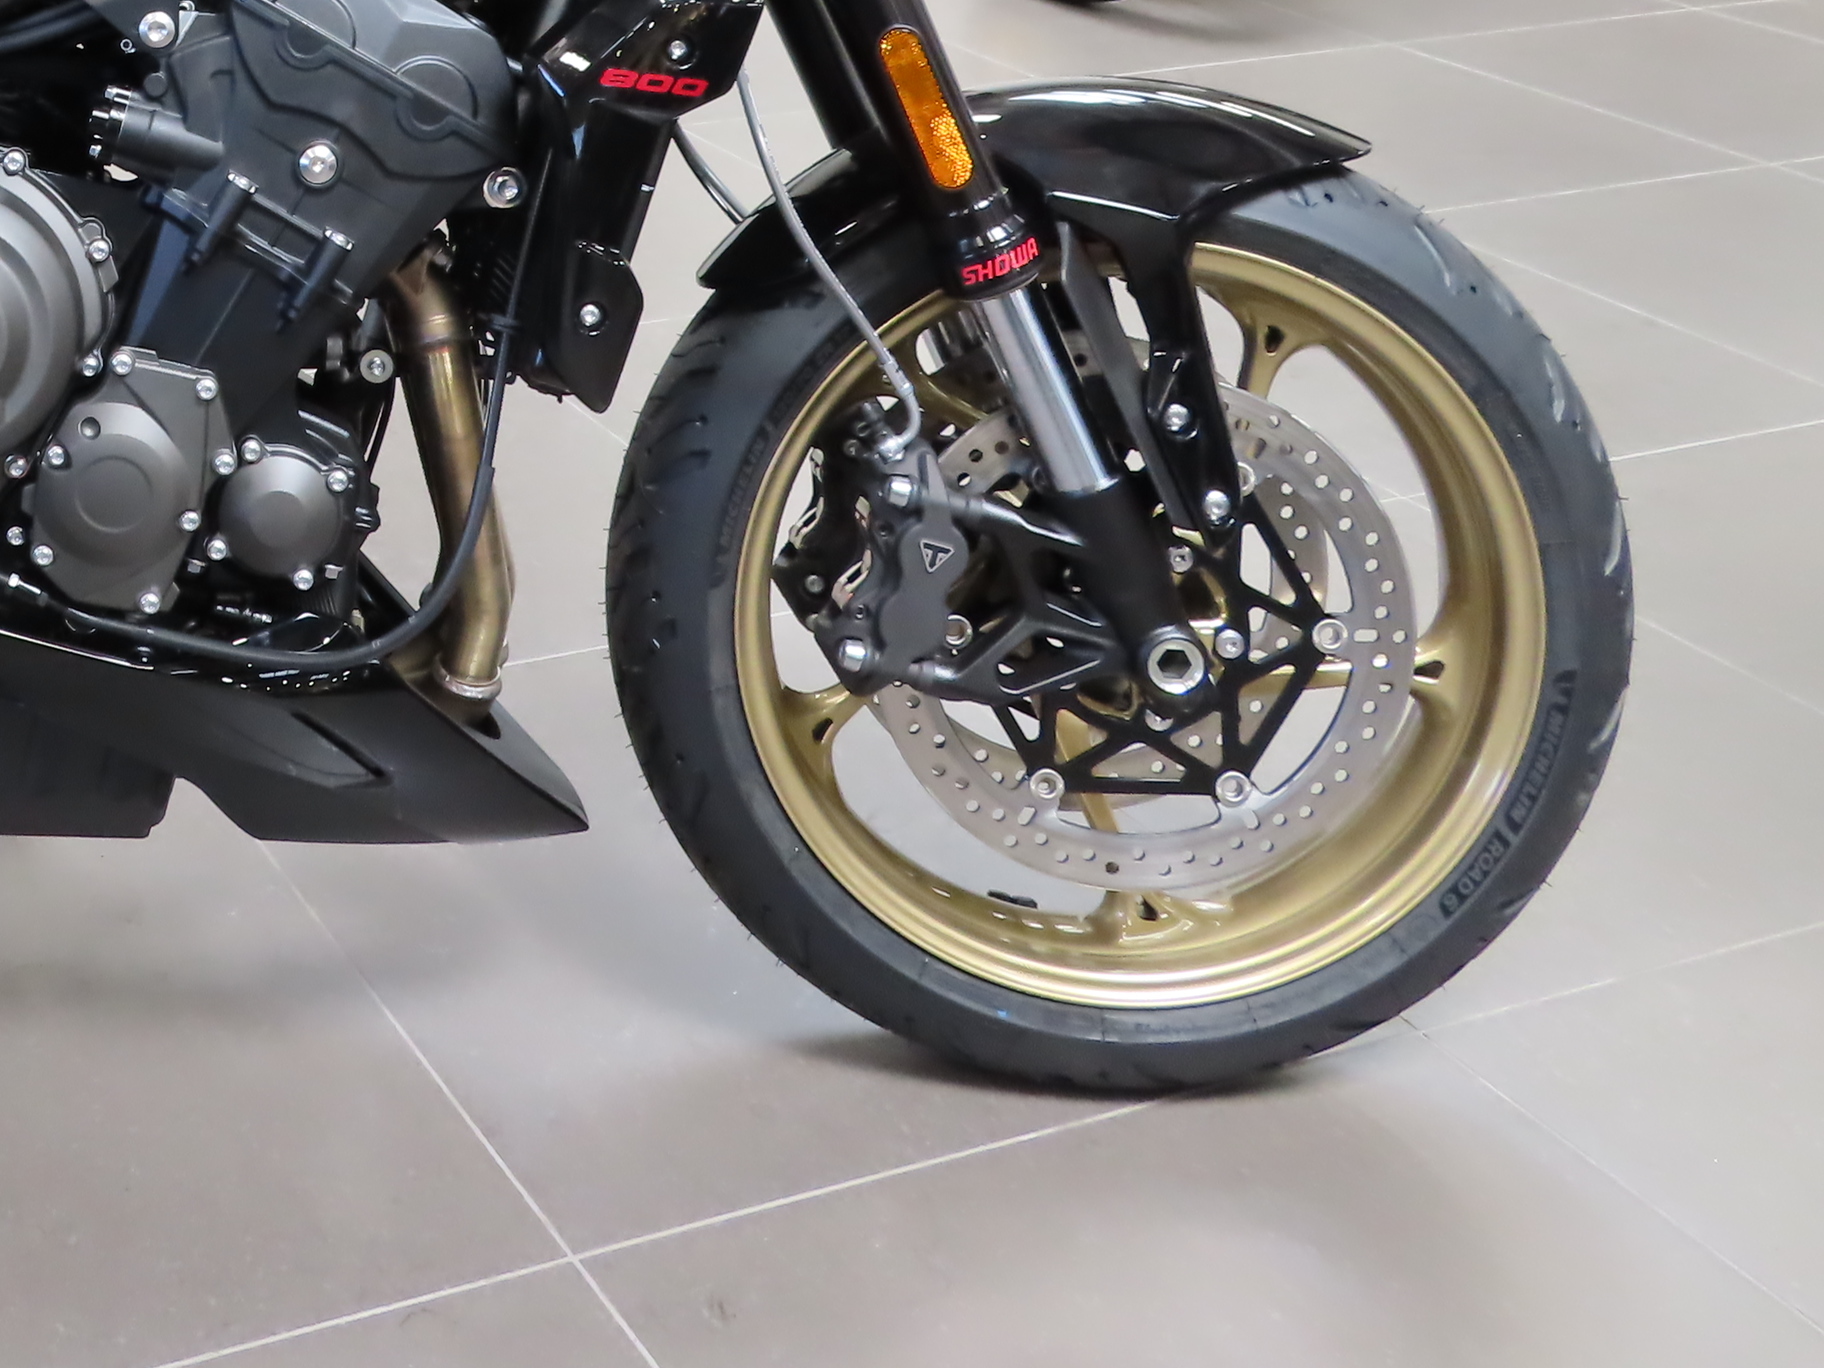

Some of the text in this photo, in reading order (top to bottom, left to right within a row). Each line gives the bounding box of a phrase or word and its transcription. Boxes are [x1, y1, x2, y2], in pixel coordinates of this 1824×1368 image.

[599, 67, 709, 98] 800
[960, 236, 1039, 286] SHOWA
[1510, 707, 1564, 823] MICHELIN
[1459, 838, 1506, 895] ROAD
